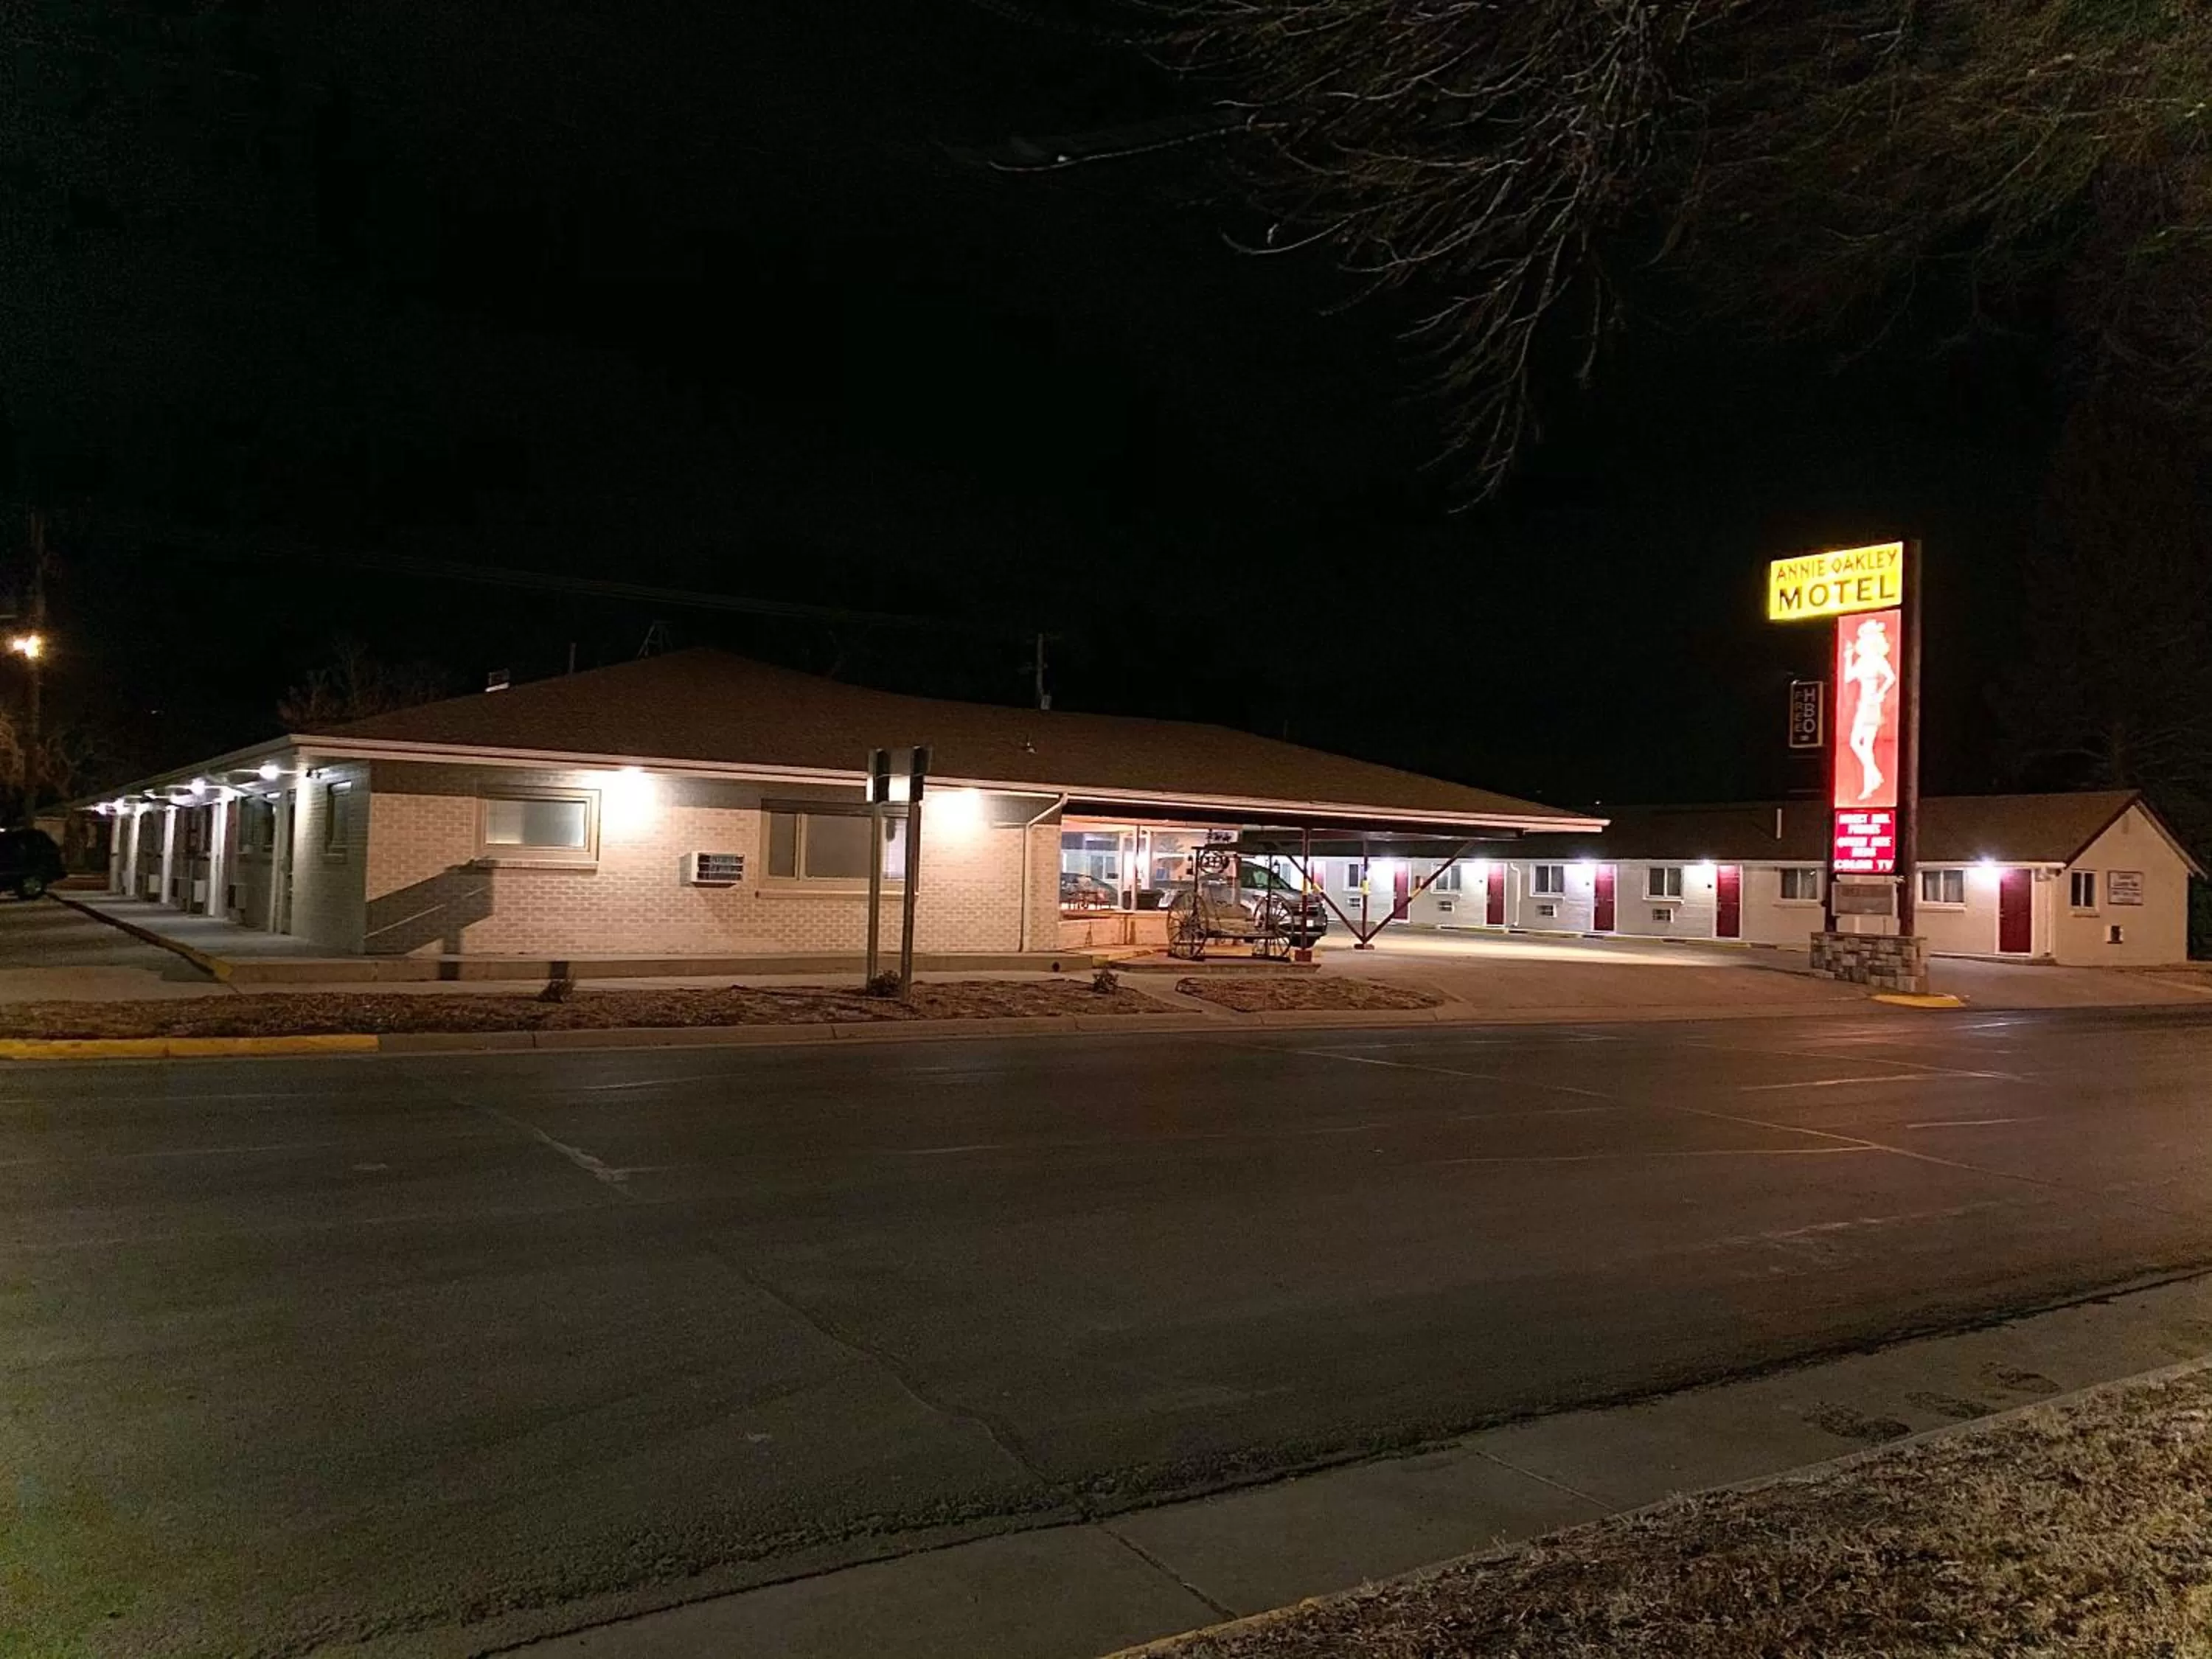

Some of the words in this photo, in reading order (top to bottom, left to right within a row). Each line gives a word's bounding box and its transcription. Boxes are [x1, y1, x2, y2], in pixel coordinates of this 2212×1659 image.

[1776, 560, 1826, 582] ANNIE
[1832, 549, 1898, 574] OAKLEY
[1778, 575, 1896, 611] MOTEL
[1804, 688, 1816, 733] HBO
